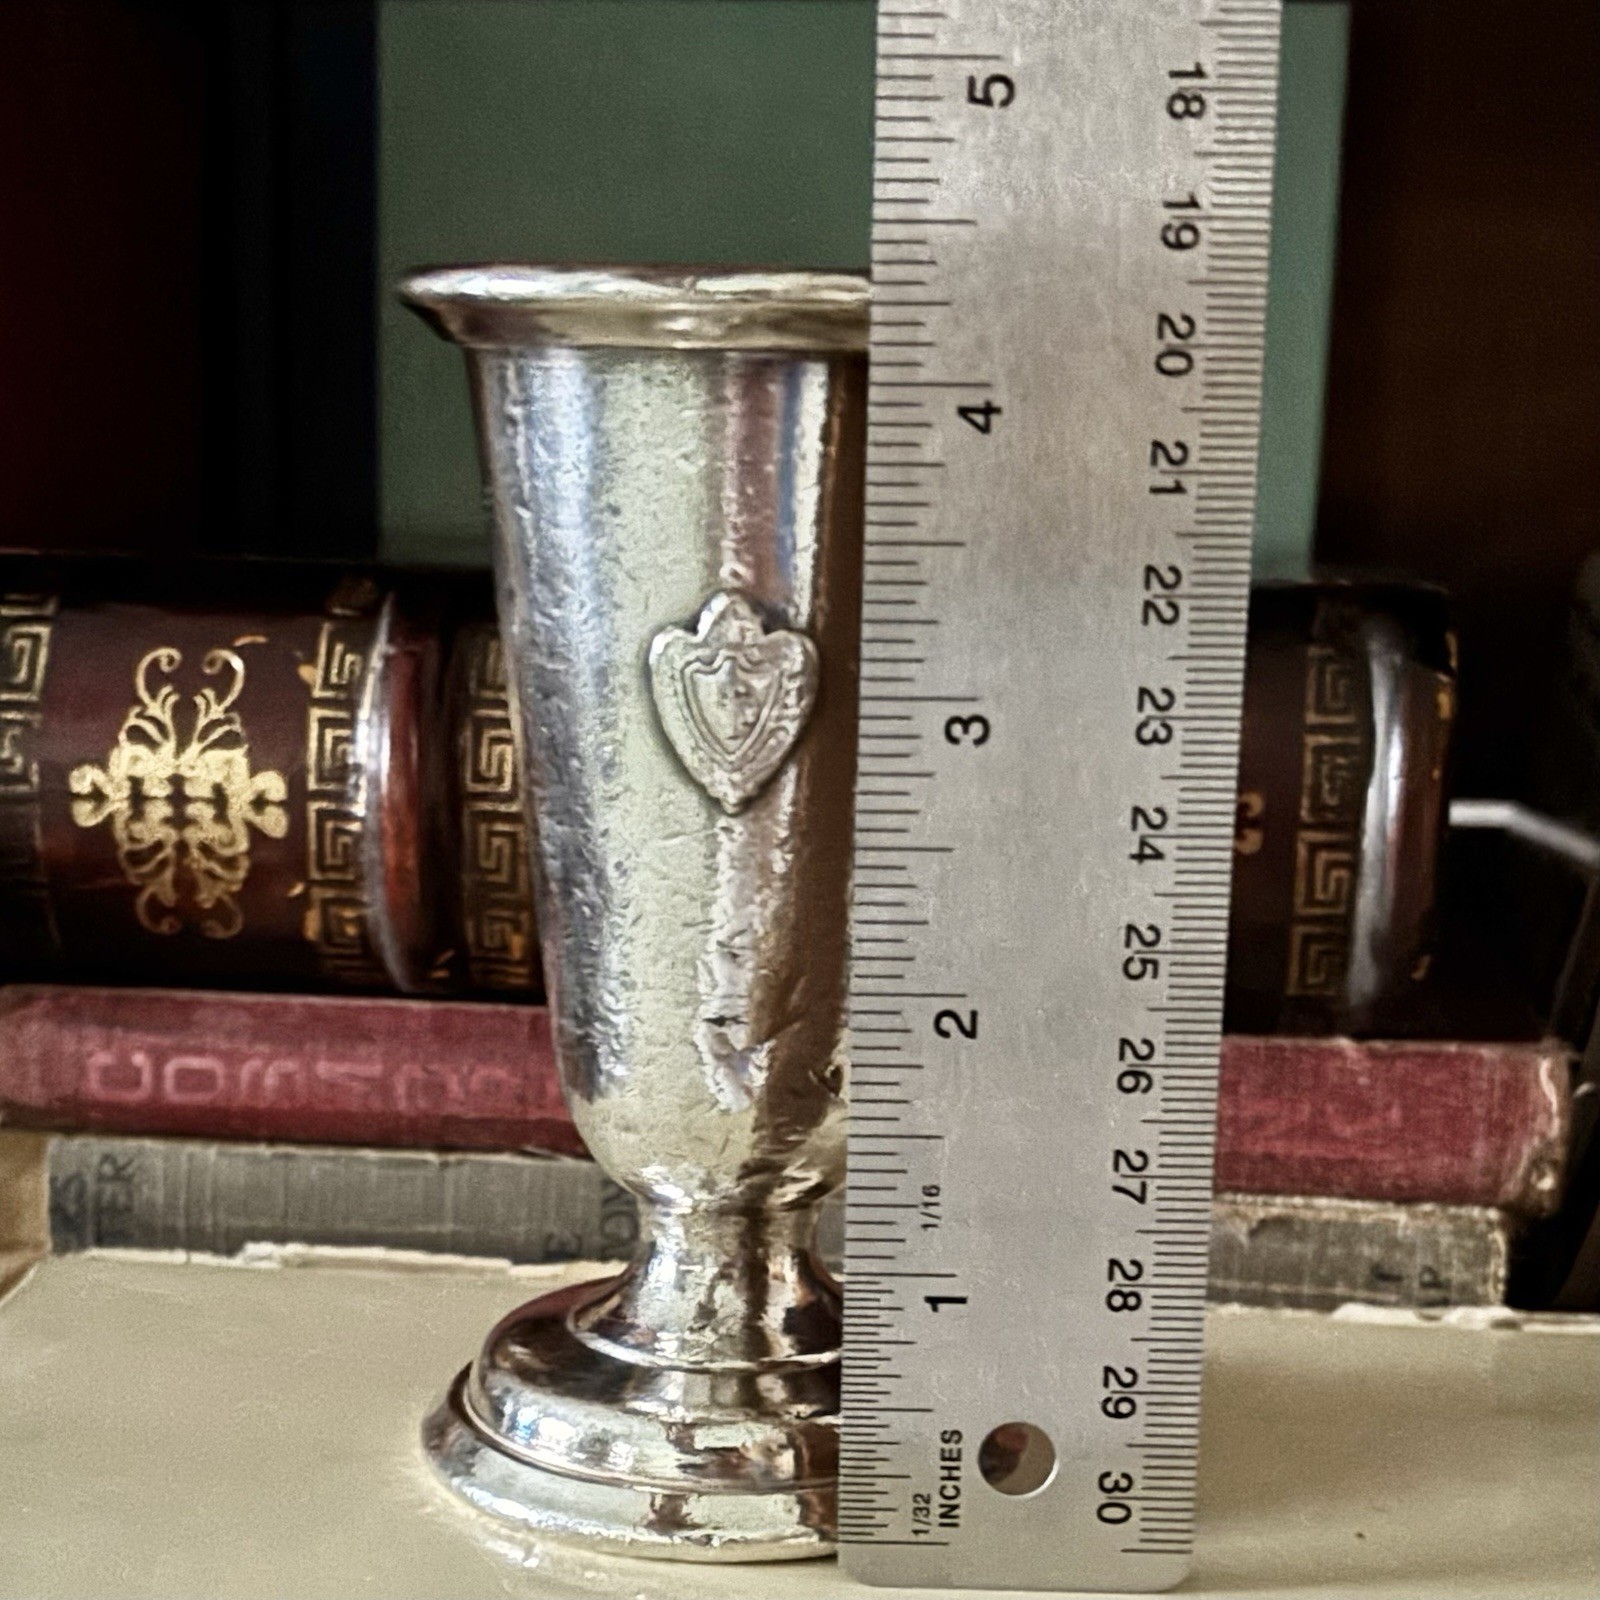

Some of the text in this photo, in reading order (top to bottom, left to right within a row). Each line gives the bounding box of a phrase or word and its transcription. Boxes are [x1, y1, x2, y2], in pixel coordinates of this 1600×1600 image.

[967, 74, 1016, 109] 5
[1166, 61, 1208, 120] 18
[1161, 195, 1201, 250] 19
[1154, 313, 1196, 376] 20
[957, 401, 1002, 435] 4
[1149, 440, 1189, 495] 21
[1142, 565, 1182, 627] 22
[945, 714, 991, 747] 3
[1136, 687, 1176, 747] 23
[1131, 806, 1169, 864] 24
[1123, 923, 1161, 981] 25
[934, 1009, 978, 1040] 2
[1117, 1038, 1155, 1095] 26
[1113, 1149, 1149, 1205] 27
[922, 1184, 942, 1231] 1/16
[925, 1294, 969, 1313] 1
[1106, 1257, 1144, 1313] 28
[1101, 1366, 1139, 1420] 29
[937, 1429, 963, 1529] INCHES
[1096, 1472, 1133, 1525] 30
[911, 1492, 932, 1537] 1/32
